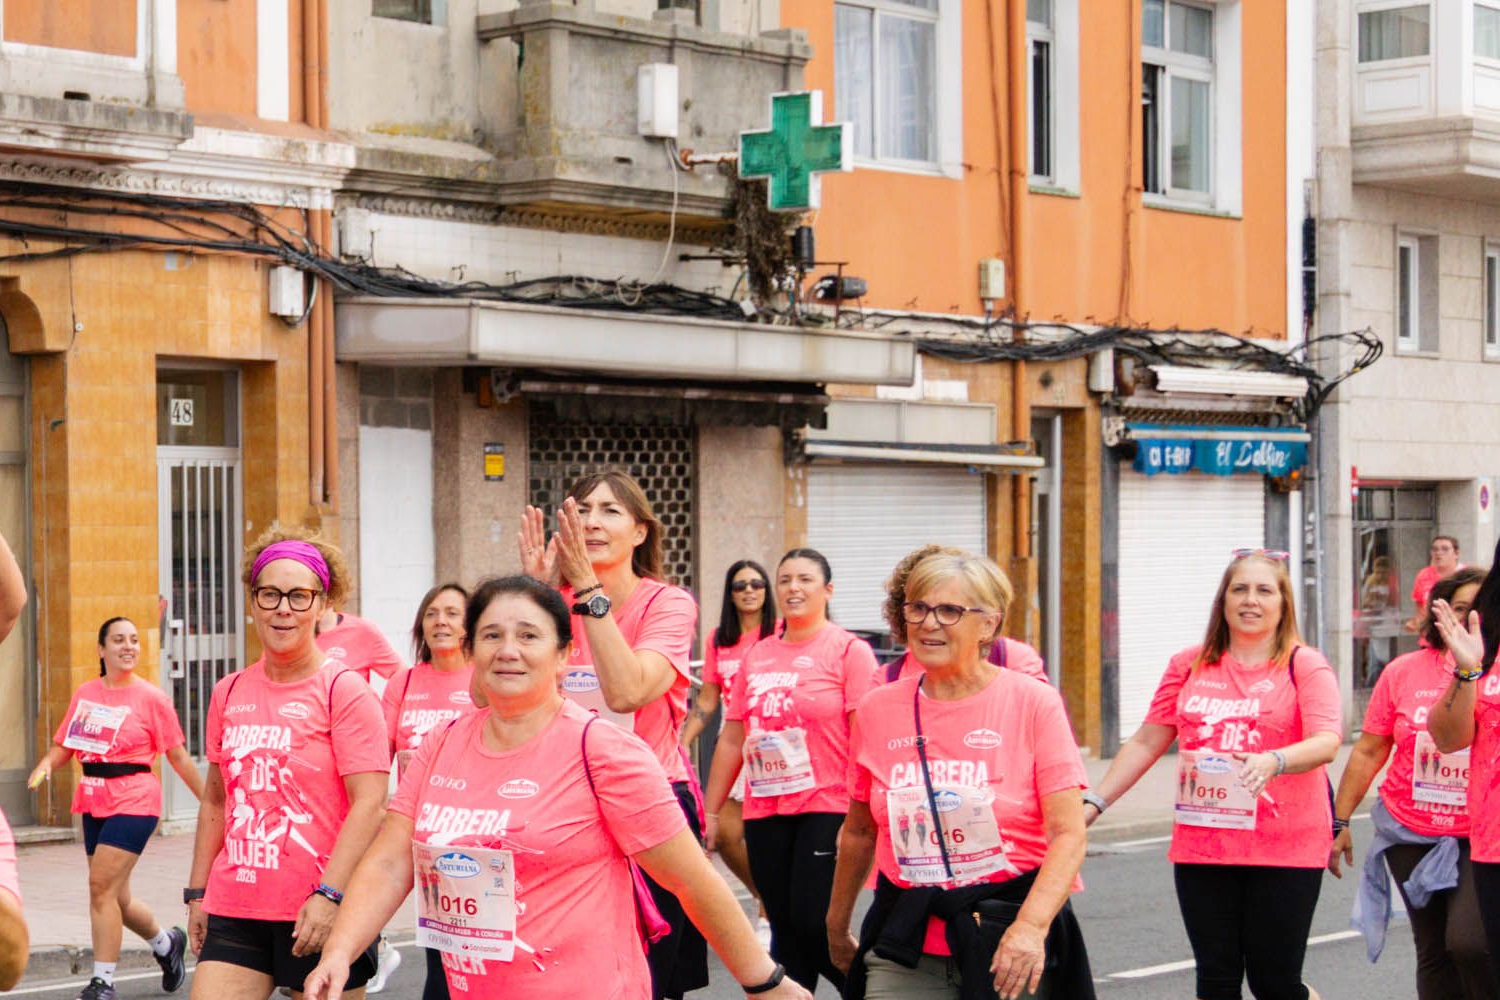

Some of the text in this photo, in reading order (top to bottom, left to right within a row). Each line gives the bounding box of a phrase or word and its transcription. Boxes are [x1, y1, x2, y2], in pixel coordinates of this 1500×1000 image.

[171, 401, 191, 423] 48
[1216, 440, 1233, 466] El
[1184, 695, 1260, 717] CARRERA
[222, 724, 291, 751] CARRERA
[1220, 721, 1248, 751] DE
[251, 757, 277, 792] DE
[1196, 785, 1227, 799] 016
[415, 802, 512, 837] CARRERA
[438, 859, 477, 874] ASTURIANA
[440, 895, 477, 916] 016
[450, 917, 467, 927] 2211
